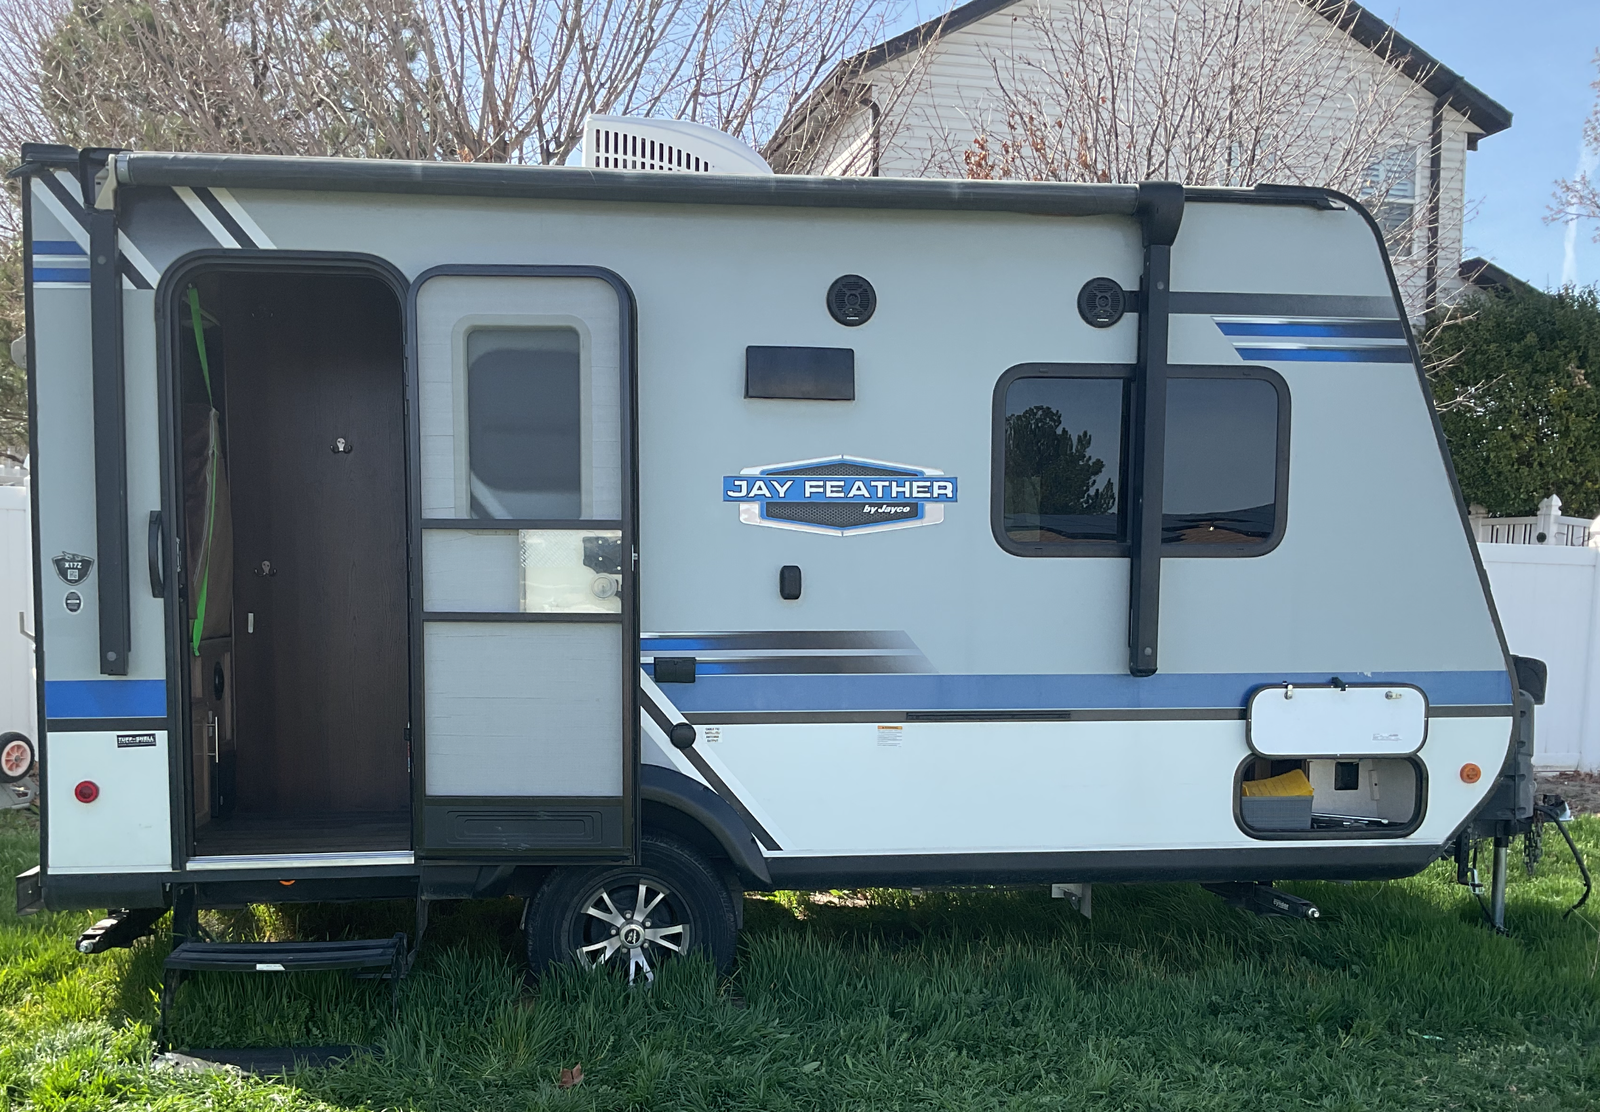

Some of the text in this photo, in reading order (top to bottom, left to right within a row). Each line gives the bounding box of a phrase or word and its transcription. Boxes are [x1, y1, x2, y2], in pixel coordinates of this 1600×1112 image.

[726, 480, 954, 498] JAY FEATHER
[863, 504, 911, 514] by Jayco
